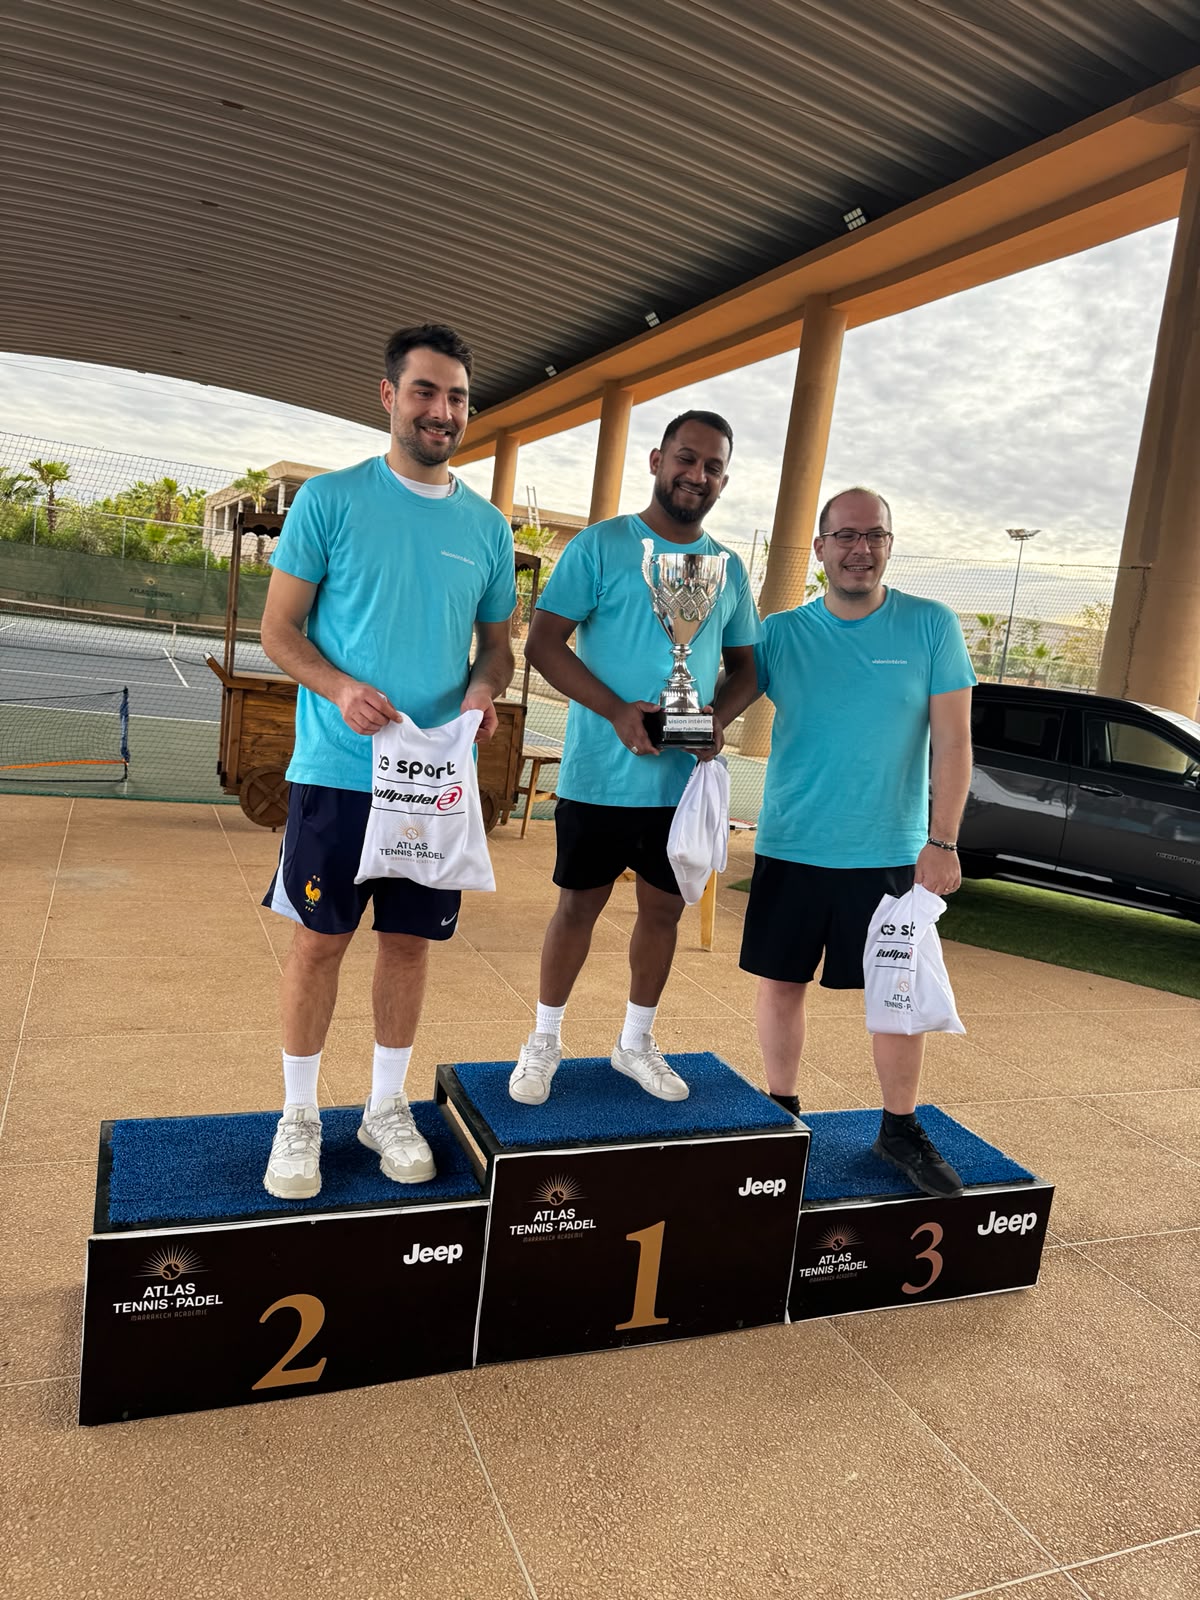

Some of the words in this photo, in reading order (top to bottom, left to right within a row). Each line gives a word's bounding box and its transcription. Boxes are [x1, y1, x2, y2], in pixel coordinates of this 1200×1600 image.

[396, 760, 456, 779] sport
[396, 841, 429, 851] ATLAS
[892, 993, 911, 1003] ATLA
[738, 1176, 787, 1197] Jeep
[533, 1208, 576, 1223] ATLAS
[977, 1210, 1038, 1236] Jeep
[403, 1243, 463, 1265] Jeep
[818, 1252, 852, 1266] ATLAS
[901, 1221, 944, 1295] 3
[615, 1220, 669, 1331] 1
[142, 1282, 196, 1299] ATLAS
[251, 1293, 327, 1390] 2
